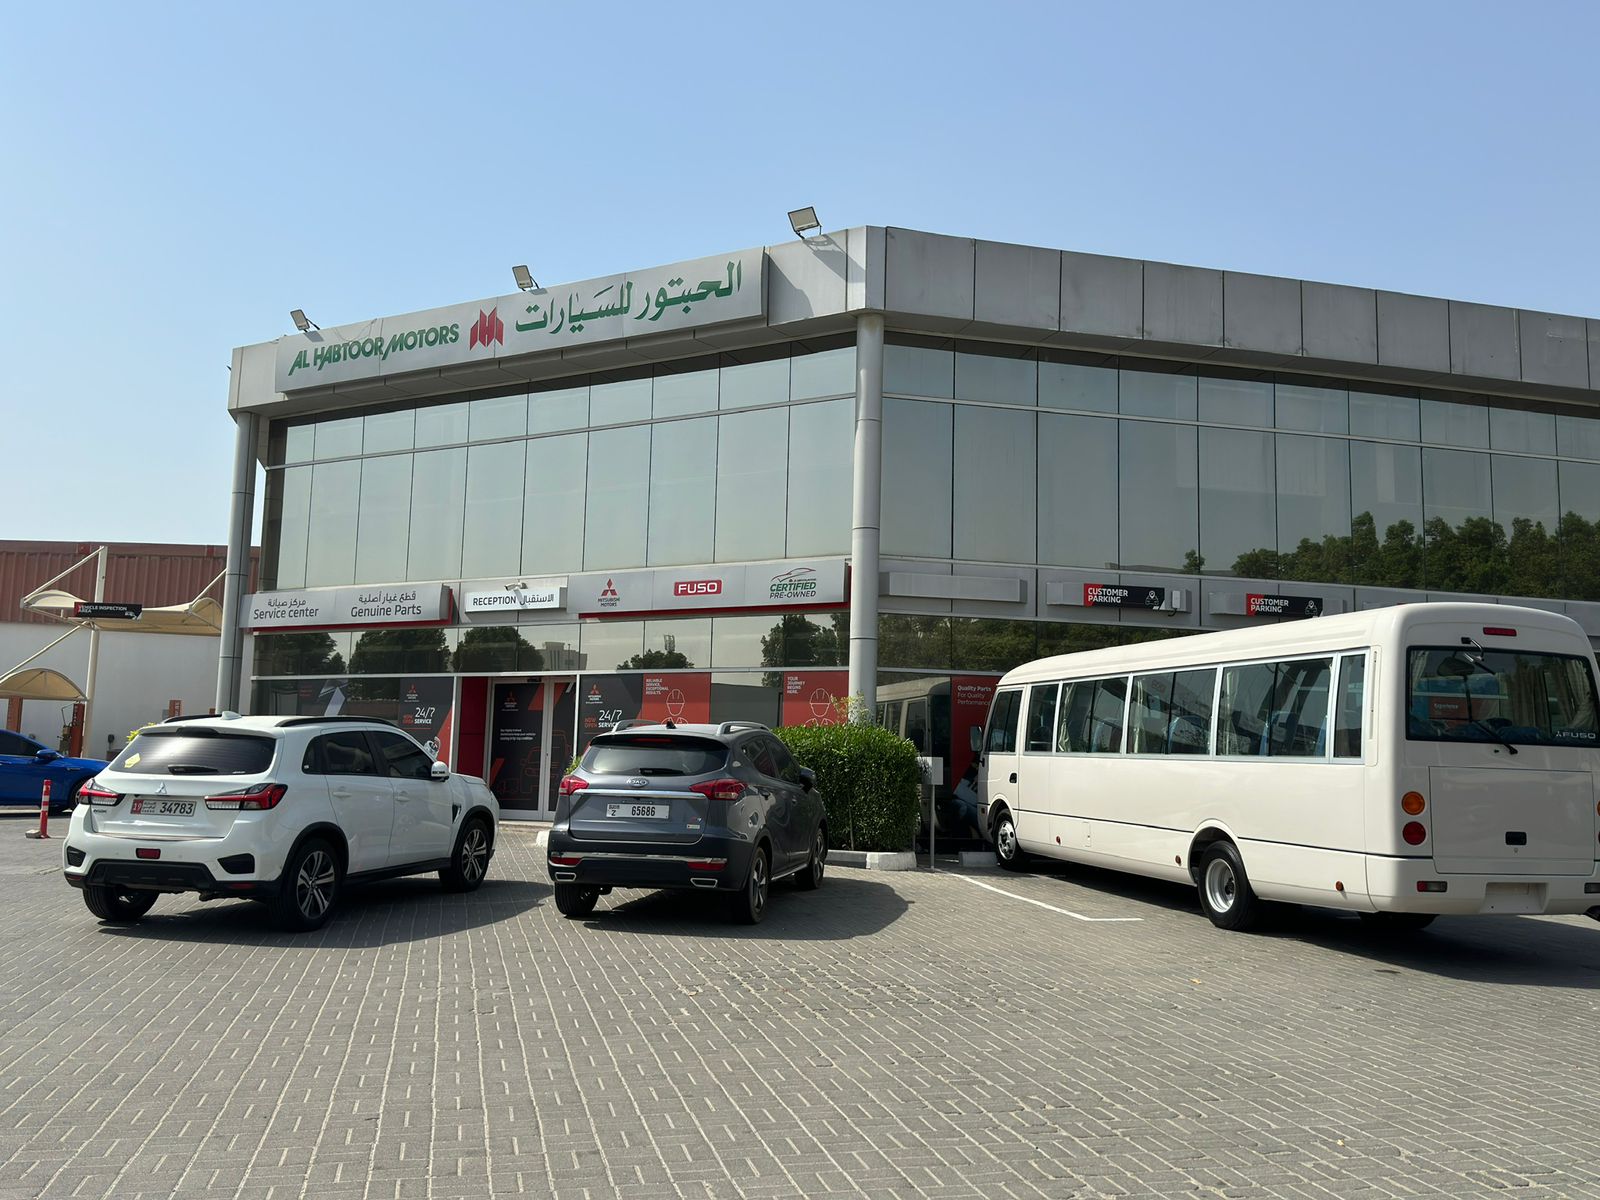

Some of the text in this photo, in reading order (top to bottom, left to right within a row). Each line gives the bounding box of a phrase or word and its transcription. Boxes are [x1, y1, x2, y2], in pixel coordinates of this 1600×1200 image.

[634, 259, 742, 321] الحبتور
[288, 323, 460, 377] AL HABTOOR MOTORS
[678, 582, 718, 594] FUSO
[769, 581, 817, 592] CERTIFIED
[1087, 587, 1129, 597] CUSTOMER
[381, 593, 398, 605] غيار
[399, 590, 417, 604] قطع
[519, 593, 555, 607] الاستقبال
[769, 590, 817, 599] PRE-OWNED
[1087, 595, 1121, 604] PARKING
[267, 597, 307, 609] مركز صيانة
[472, 595, 517, 607] RECEPTION
[1250, 597, 1289, 607] CUSTOMER
[253, 606, 320, 620] Service center
[350, 603, 422, 618] Genuine Parts
[1250, 605, 1283, 613] PARKING
[415, 706, 436, 719] 24/7
[598, 709, 623, 723] 24/7
[1562, 731, 1596, 739] FUSO
[160, 802, 194, 815] 34783
[611, 809, 617, 817] Z
[631, 805, 656, 817] 65686
